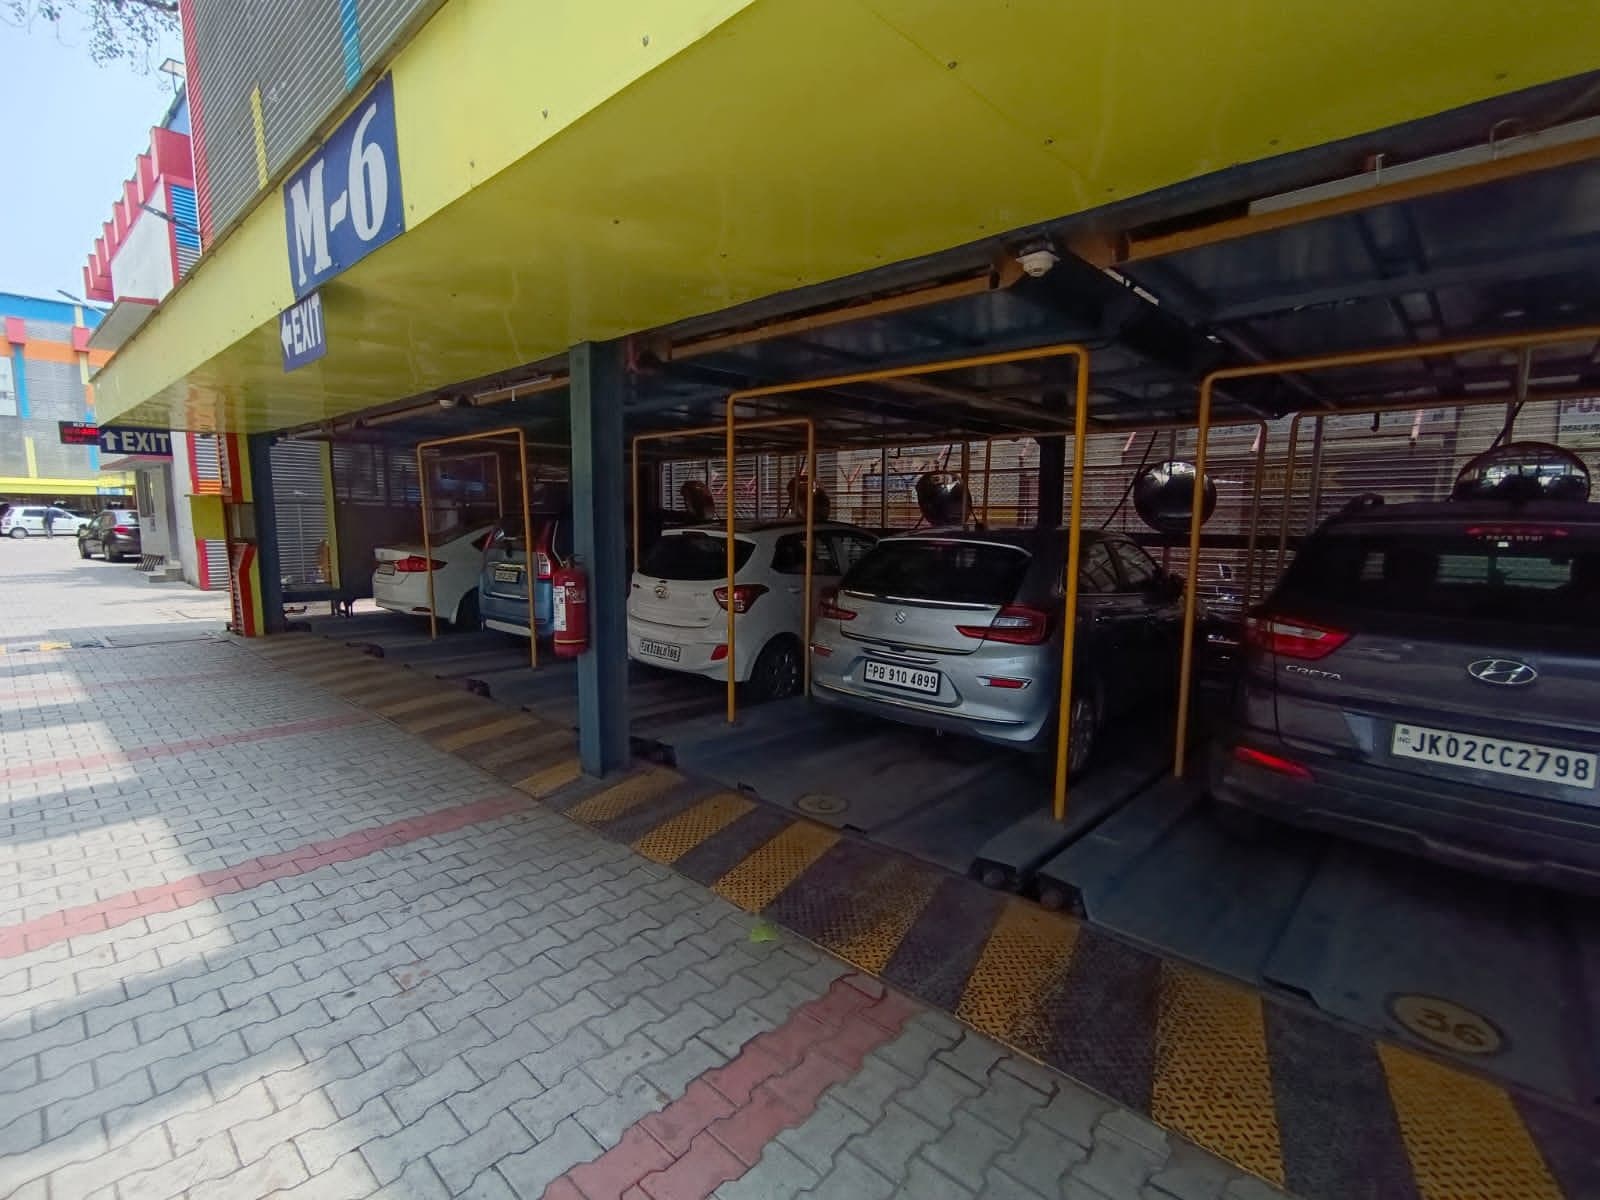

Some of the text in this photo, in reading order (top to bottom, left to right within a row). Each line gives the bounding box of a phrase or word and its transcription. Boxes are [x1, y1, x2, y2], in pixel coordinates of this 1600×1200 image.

[290, 102, 388, 287] M-6
[291, 292, 321, 356] EXIT
[120, 431, 169, 453] EXIT
[872, 665, 937, 689] PB 910 4899
[1411, 732, 1590, 782] JK02CC2798
[1415, 1008, 1488, 1046] 36
